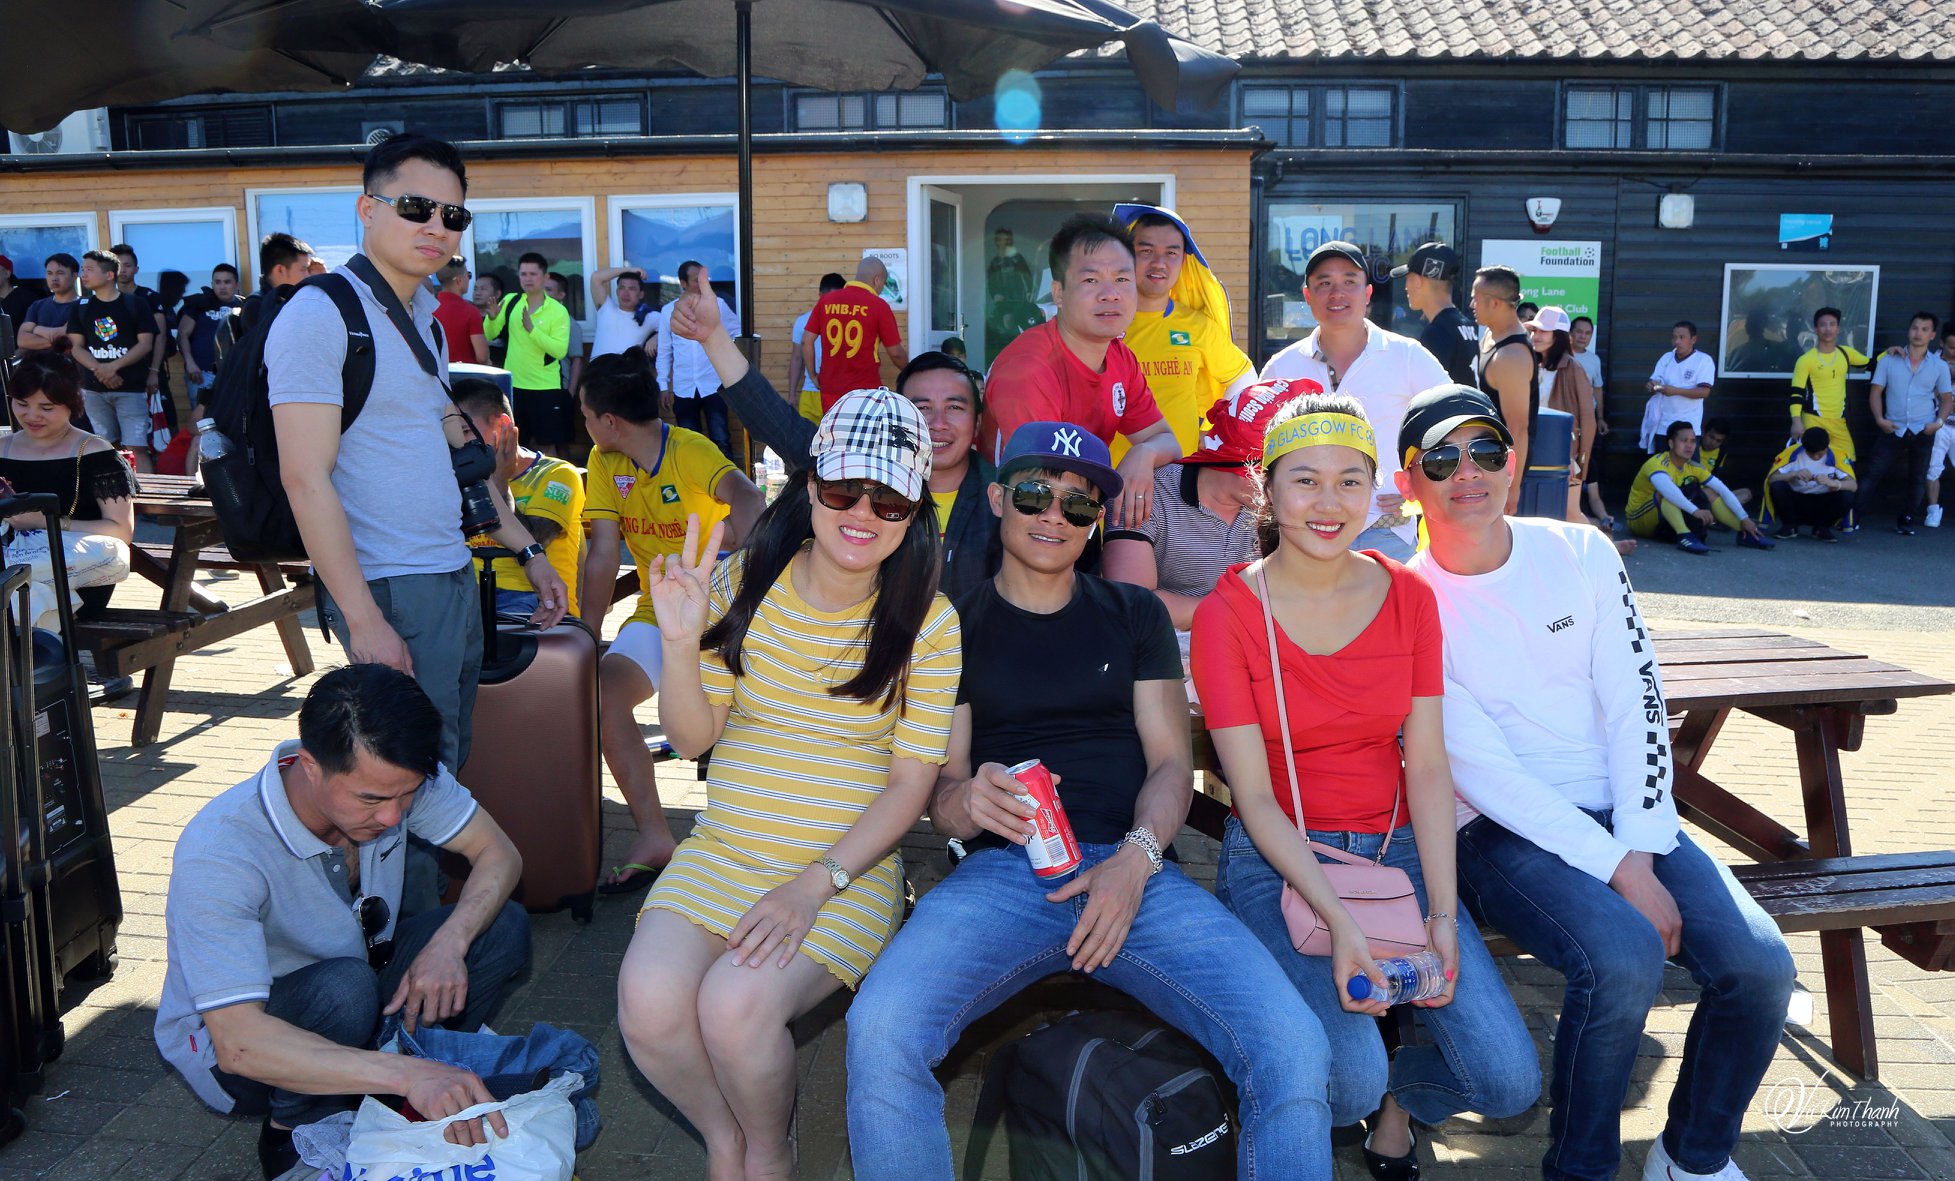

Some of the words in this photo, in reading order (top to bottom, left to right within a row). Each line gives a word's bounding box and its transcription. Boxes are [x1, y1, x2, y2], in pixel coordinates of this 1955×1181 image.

[1541, 247, 1581, 256] Football
[1540, 257, 1594, 266] Foundation
[1520, 289, 1539, 298] ong
[1542, 287, 1565, 296] Lane
[825, 304, 868, 316] VNB.FC
[1565, 304, 1588, 313] Club
[826, 318, 863, 358] 99
[1277, 420, 1346, 447] GLASGOW
[1350, 423, 1364, 440] FC
[1051, 427, 1083, 458] NY
[1547, 615, 1574, 633] VANS
[1639, 660, 1664, 726] VANS
